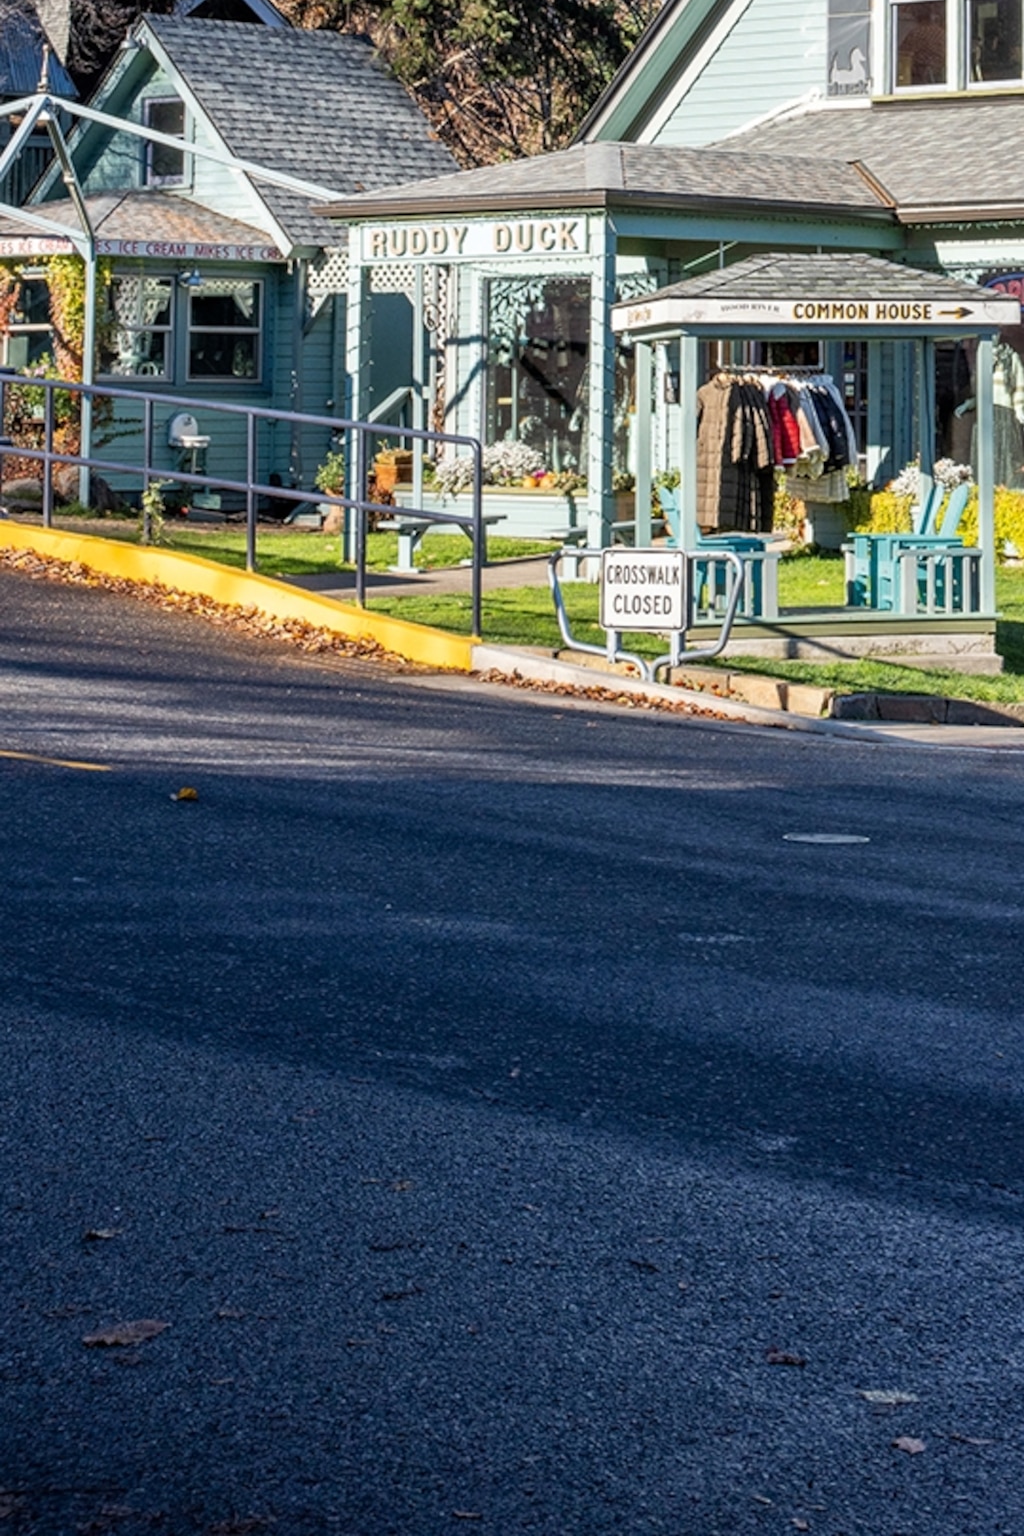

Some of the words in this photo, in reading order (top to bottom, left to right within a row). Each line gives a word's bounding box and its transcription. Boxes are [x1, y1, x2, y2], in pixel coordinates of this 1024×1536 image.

[370, 226, 467, 257] RUDDY
[494, 221, 579, 252] DUCK
[119, 241, 138, 254] ICE
[146, 242, 186, 256] CREAM
[194, 244, 229, 258] MIKES
[235, 246, 254, 260] ICE
[792, 303, 869, 320] COMMON
[875, 303, 931, 320] HOUSE
[607, 565, 679, 585] CROSSWALK
[613, 594, 673, 615] CLOSED
